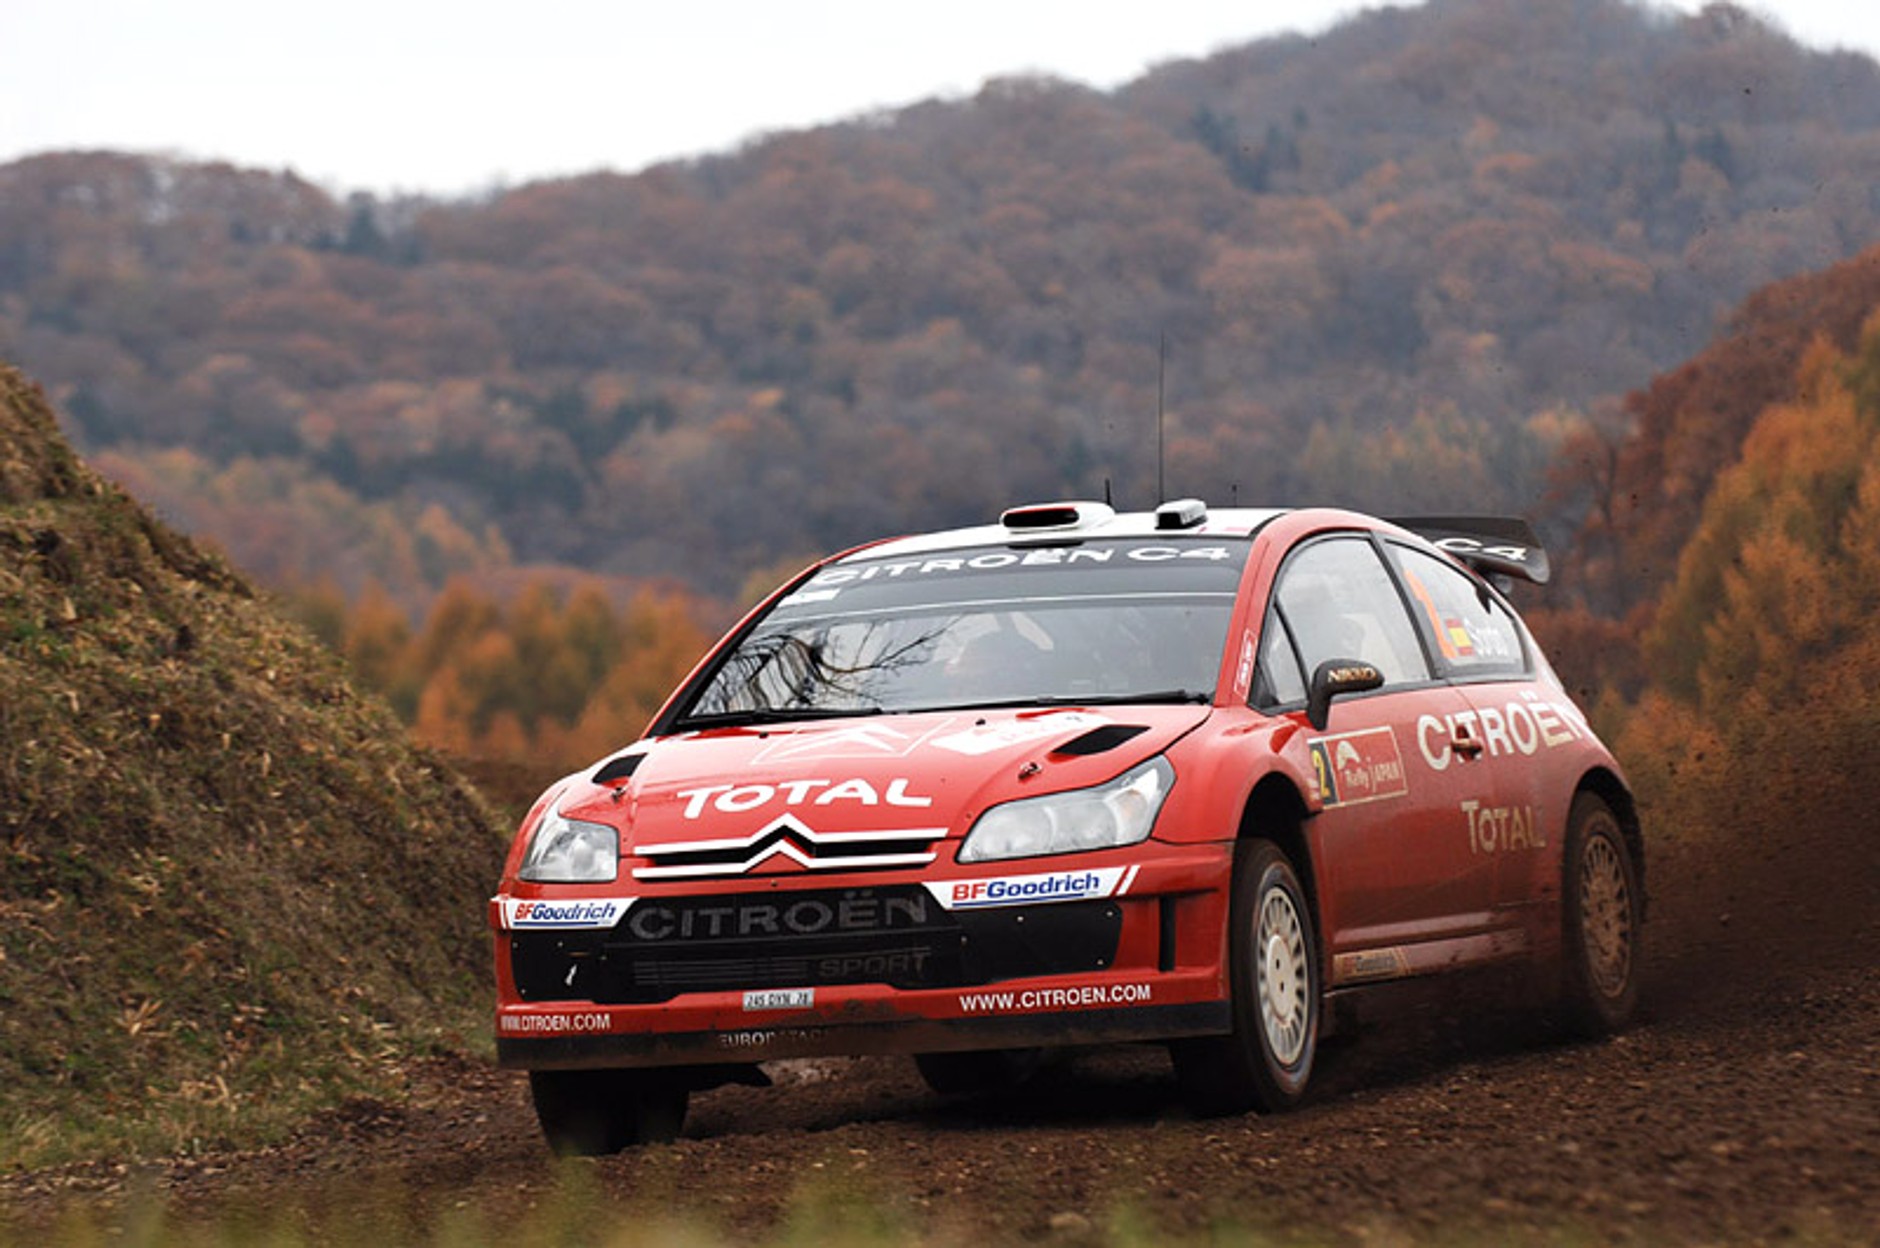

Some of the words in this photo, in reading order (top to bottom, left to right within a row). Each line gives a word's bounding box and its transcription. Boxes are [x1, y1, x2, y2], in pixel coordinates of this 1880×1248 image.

[1127, 546, 1231, 562] C4
[1311, 749, 1331, 798] 2
[676, 777, 932, 819] TOTAL
[1461, 800, 1547, 854] TOTAL
[951, 873, 1100, 901] BFGoodrich
[514, 902, 616, 920] BFGoodrich
[629, 890, 928, 939] CITROËN
[818, 951, 931, 978] SPORT
[959, 984, 1151, 1012] WWW.CITROEN.COM
